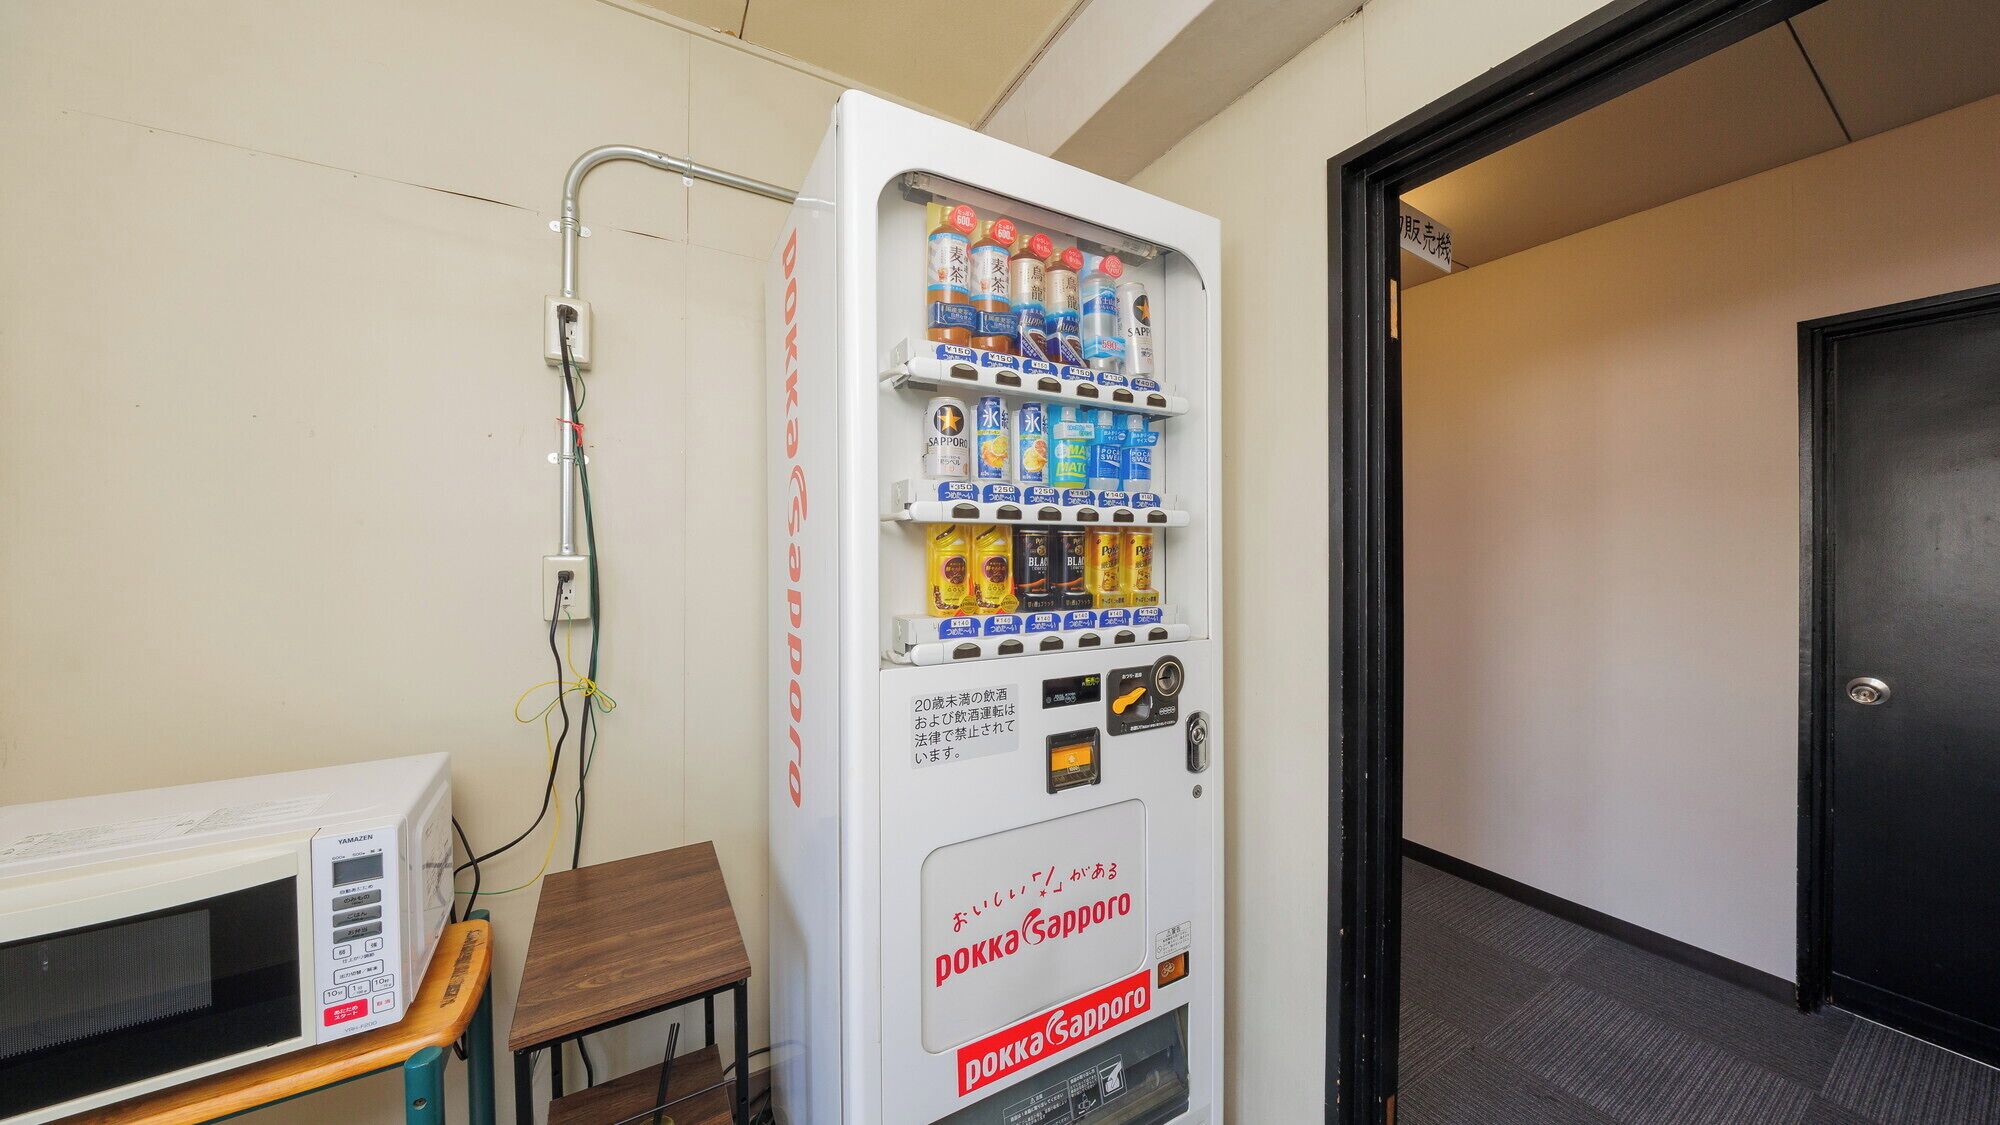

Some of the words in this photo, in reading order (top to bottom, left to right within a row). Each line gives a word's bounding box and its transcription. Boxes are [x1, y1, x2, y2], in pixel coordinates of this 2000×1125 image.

[950, 246, 963, 283] 麦茶
[992, 258, 1005, 293] 麦茶
[946, 345, 971, 355] ¥150
[989, 353, 1012, 363] ¥150
[928, 437, 968, 448] SAPPORO
[914, 687, 1008, 713] 20歳未満の飲酒
[914, 703, 1016, 730] および飲酒運転は
[914, 719, 1016, 748] 法律で禁止されて
[915, 746, 960, 764] います。
[338, 834, 374, 845] YAMAZEN
[344, 894, 370, 904] のみもの
